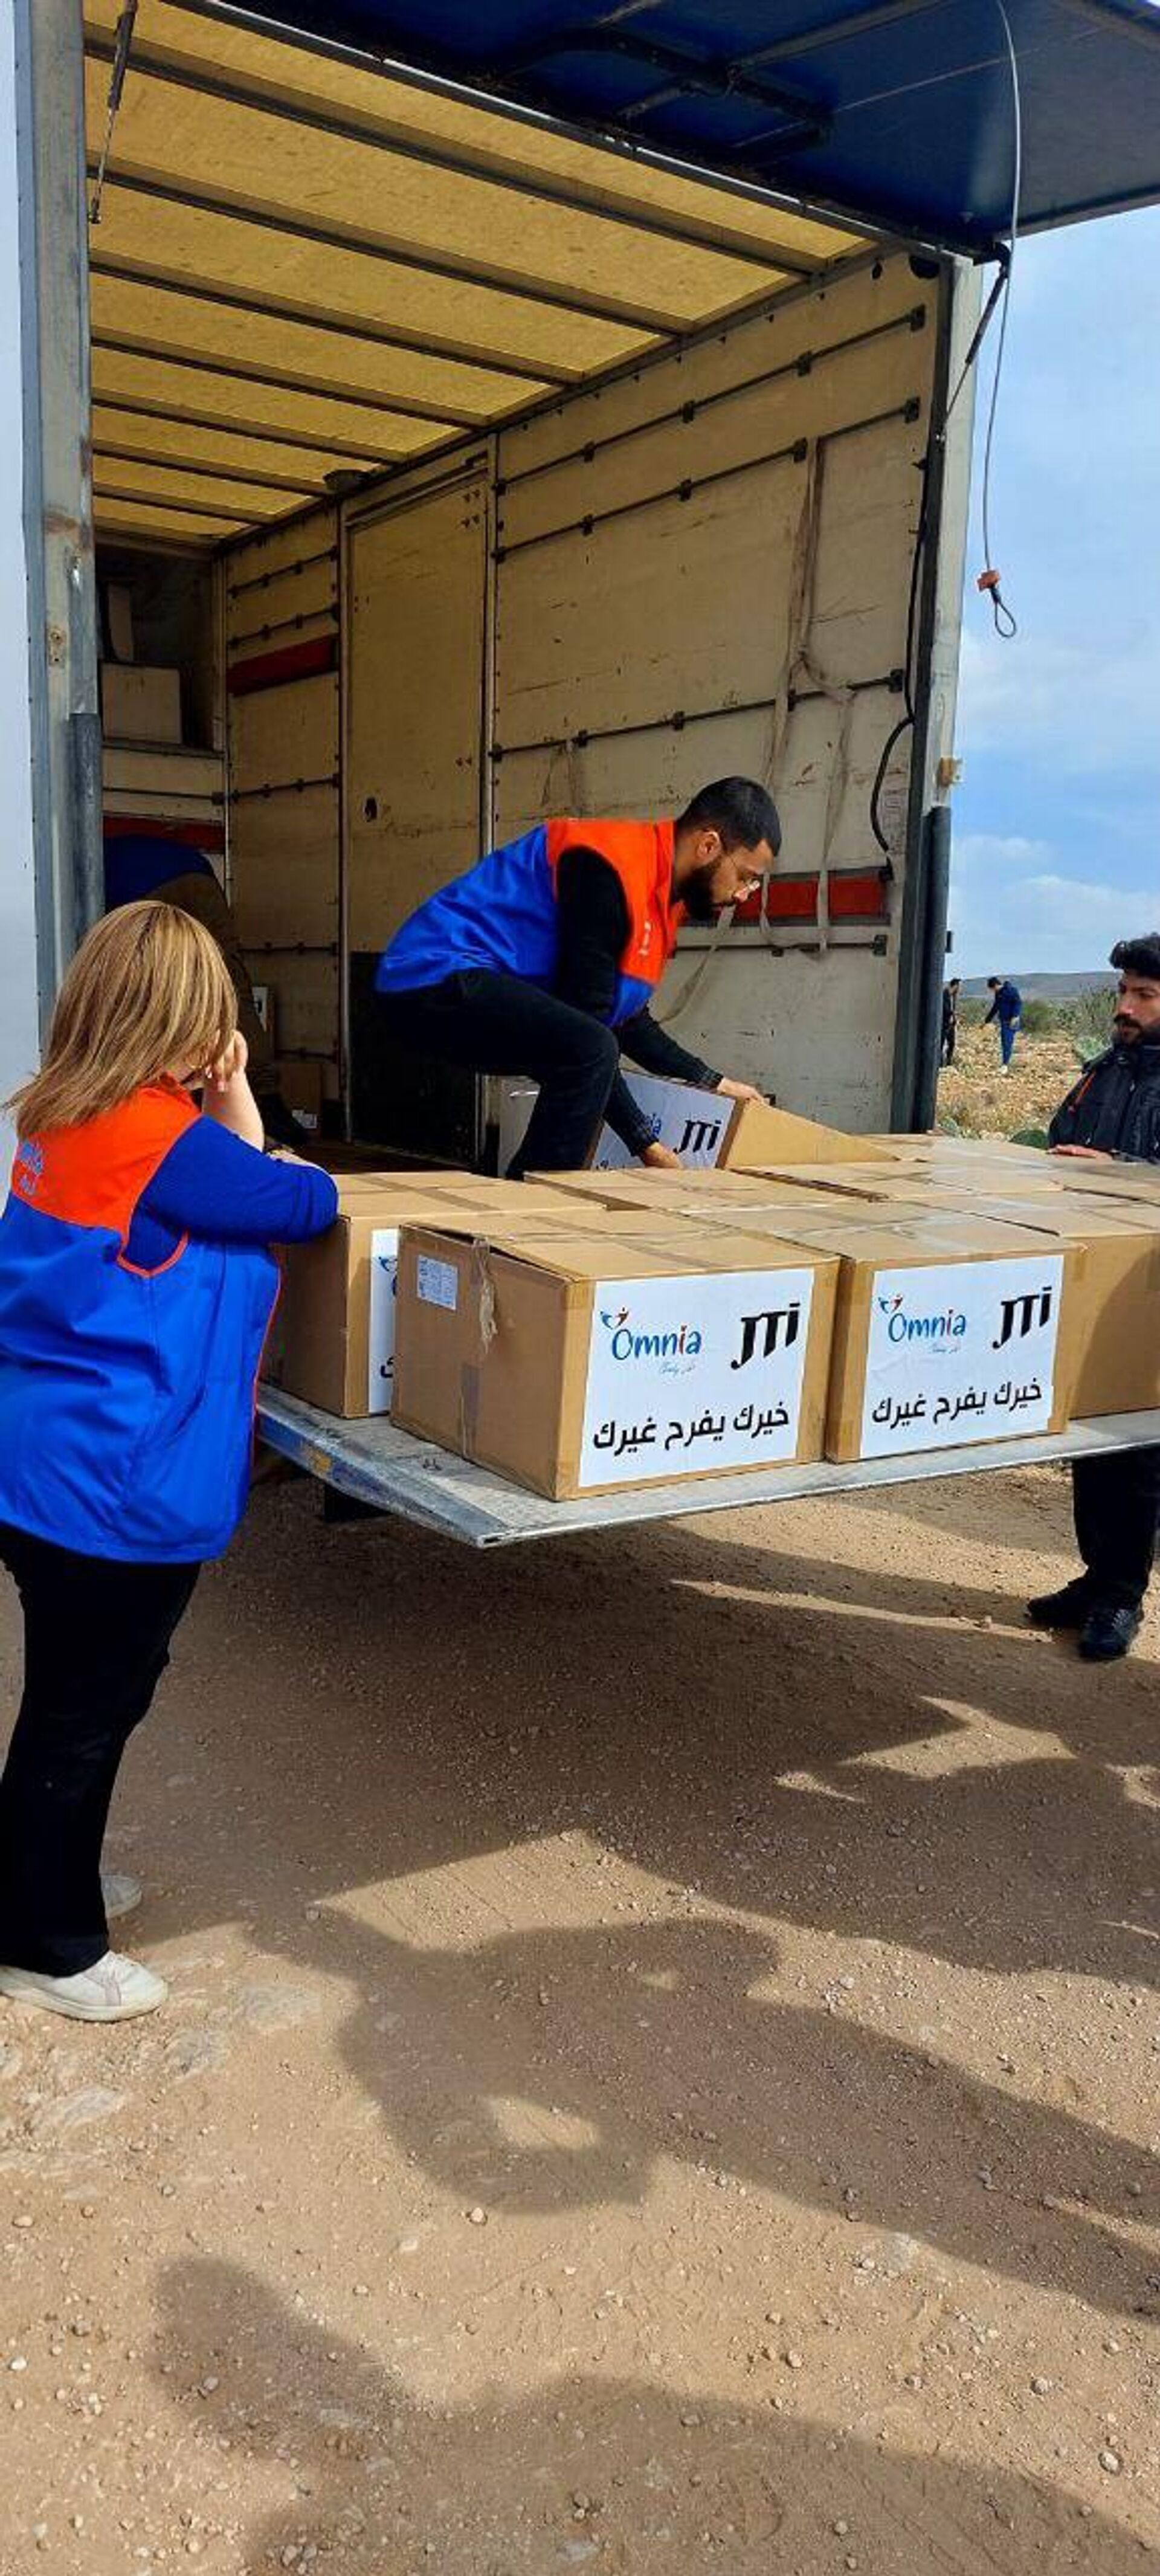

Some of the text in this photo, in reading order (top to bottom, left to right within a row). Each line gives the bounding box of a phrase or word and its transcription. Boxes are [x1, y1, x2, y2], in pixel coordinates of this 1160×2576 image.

[612, 1325, 702, 1361] Omnia
[888, 1309, 967, 1343] Omnia
[872, 1377, 1042, 1430] خيرك يفرح غيرك
[593, 1401, 789, 1456] خيرك يفرح غيرك
